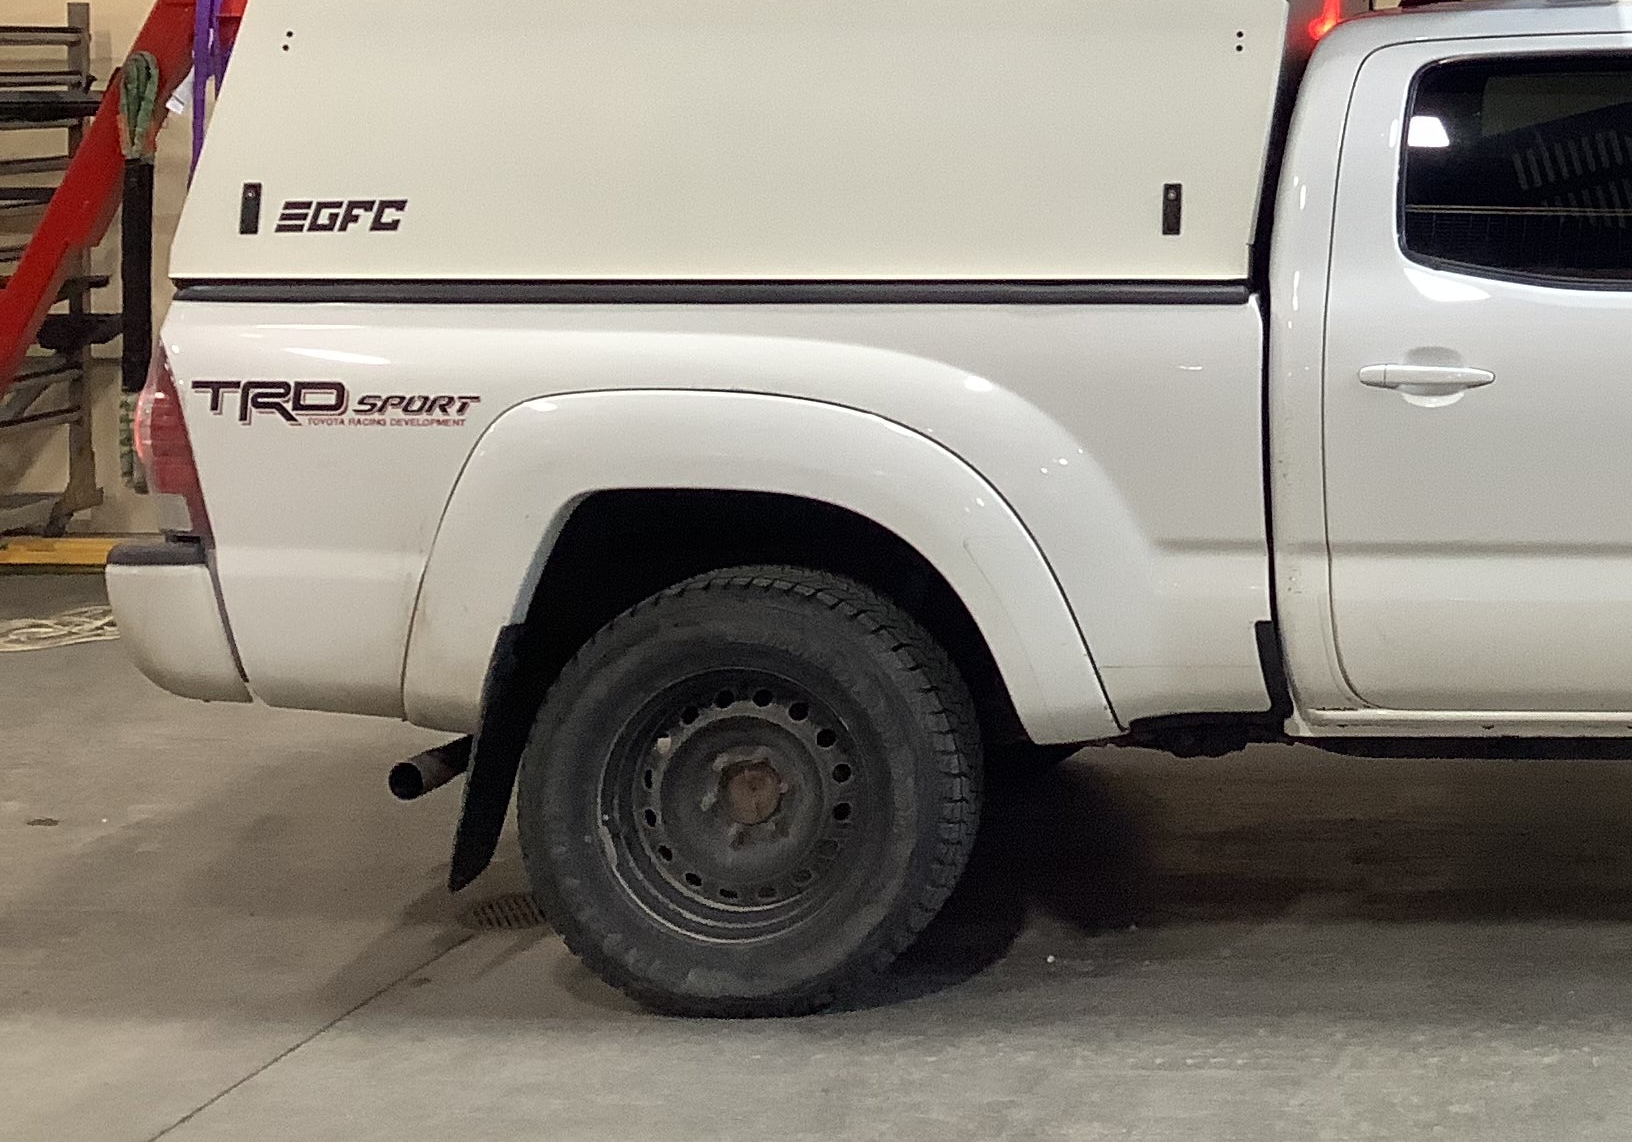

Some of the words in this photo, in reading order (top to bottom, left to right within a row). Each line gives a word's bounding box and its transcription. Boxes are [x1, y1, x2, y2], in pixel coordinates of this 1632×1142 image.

[191, 380, 349, 425] TRD
[352, 394, 481, 417] SPORT
[307, 417, 346, 427] TOYOTA
[349, 417, 387, 427] RACING
[389, 417, 467, 427] DEVELOPMENT
